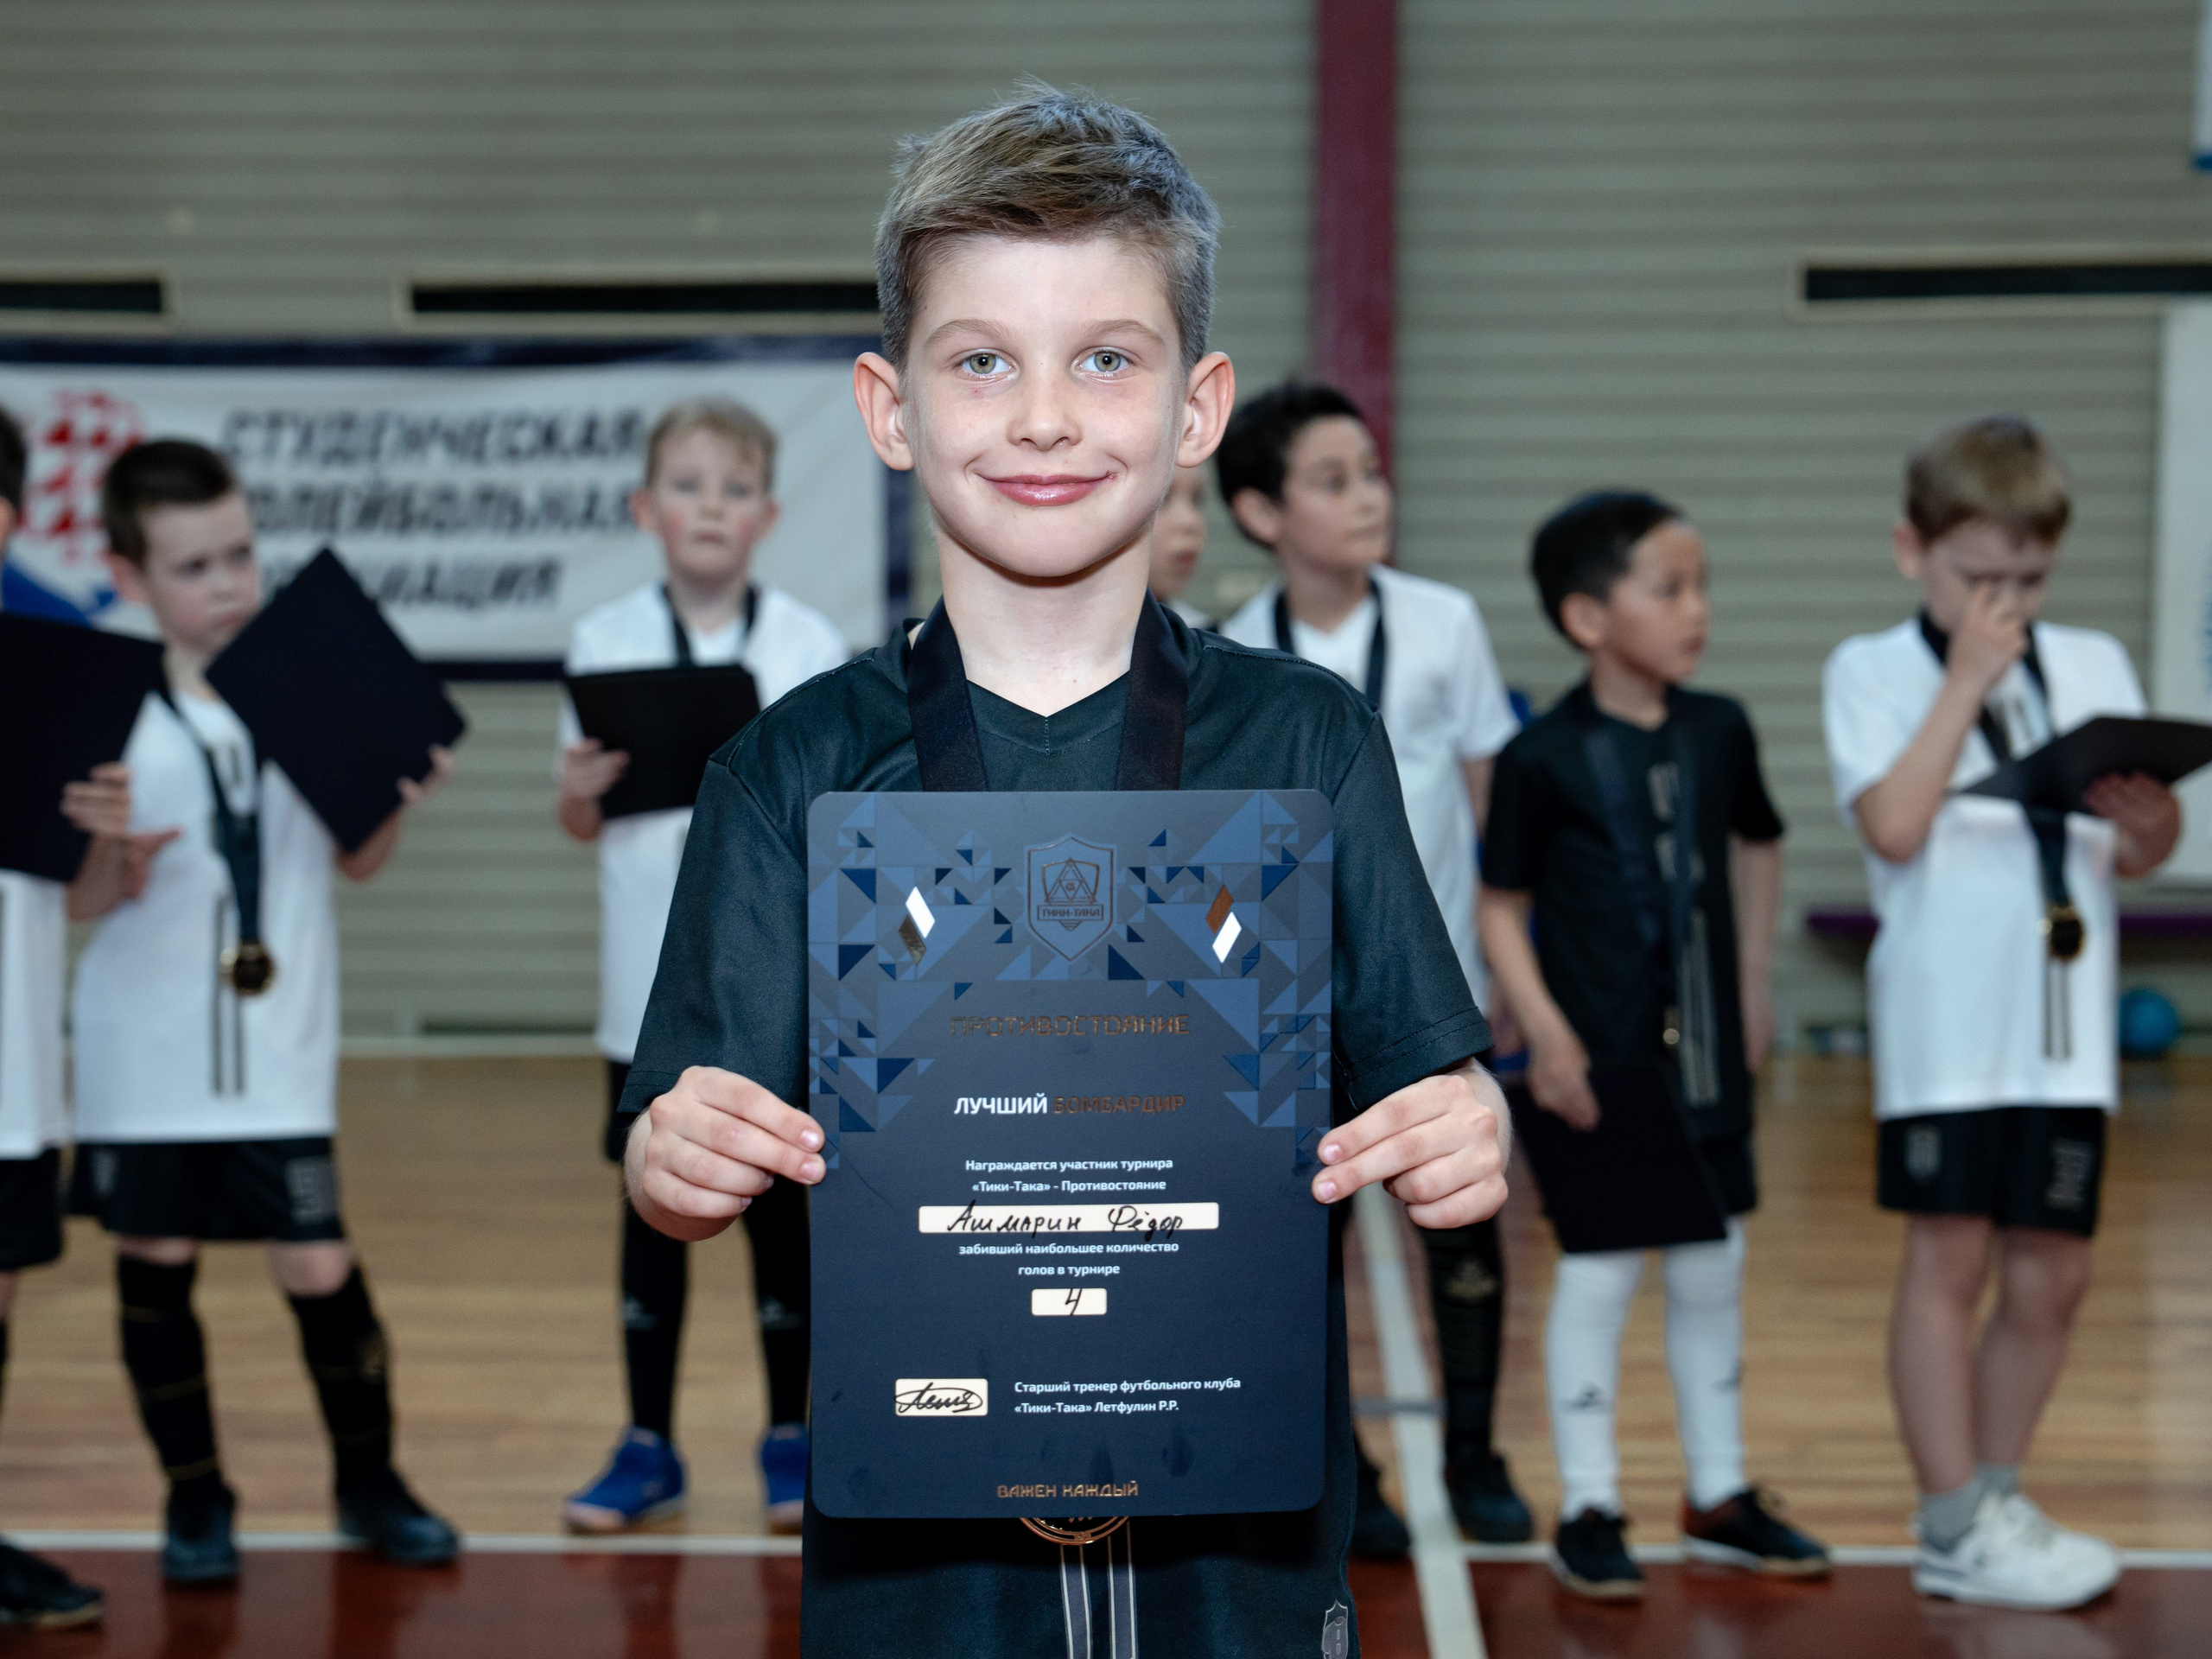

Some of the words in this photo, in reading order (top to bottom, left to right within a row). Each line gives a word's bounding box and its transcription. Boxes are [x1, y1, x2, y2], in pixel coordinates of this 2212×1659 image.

[1042, 908, 1101, 917] ТИКИ-ТАКА
[950, 1014, 1191, 1036] ПРОТИВОСТОЯНИЕ
[953, 1092, 1048, 1116] ЛУЧШИЙ
[1053, 1095, 1185, 1115] БОМБАРДИР
[964, 1160, 1058, 1172] Награждается
[1059, 1160, 1118, 1172] участник
[1121, 1160, 1173, 1171] турнира
[971, 1180, 1052, 1192] «Тики-Така»
[1061, 1179, 1167, 1193] Противостояние
[948, 1199, 1082, 1238] Ашмарин
[958, 1243, 1024, 1255] забивший
[1025, 1243, 1104, 1255] наибольшее
[1105, 1243, 1179, 1254] количество
[1017, 1266, 1056, 1276] голов
[1057, 1266, 1065, 1275] в
[1066, 1265, 1121, 1278] турнире
[1065, 1287, 1083, 1316] 4
[1014, 1381, 1071, 1394] Старший
[1072, 1382, 1118, 1395] тренер
[1119, 1379, 1202, 1394] футбольного
[1204, 1376, 1242, 1391] клуба
[1014, 1402, 1093, 1414] «Тики-Така»
[1093, 1401, 1157, 1414] Летфулин
[996, 1483, 1058, 1499] ВАЖЕН
[1061, 1479, 1140, 1498] КАЖДЫЙ
